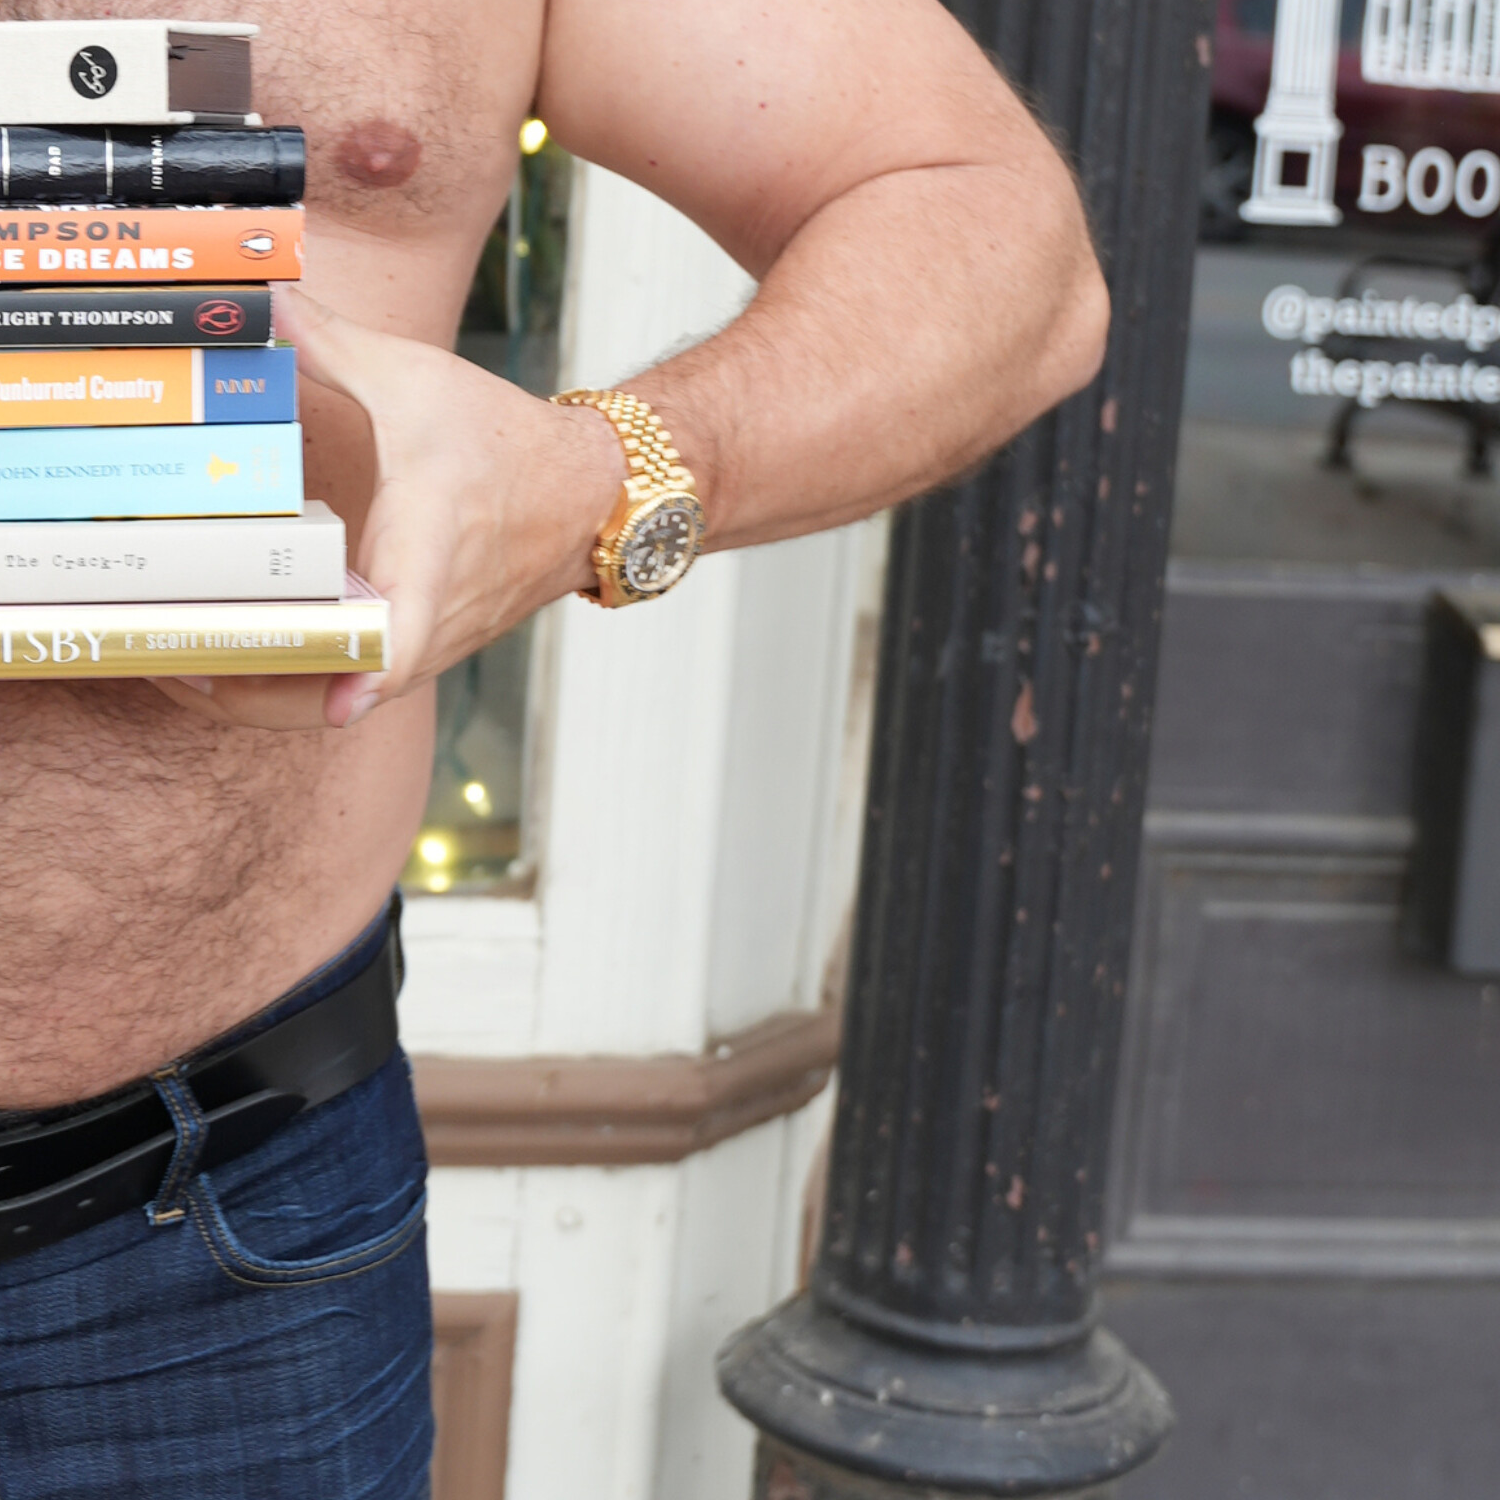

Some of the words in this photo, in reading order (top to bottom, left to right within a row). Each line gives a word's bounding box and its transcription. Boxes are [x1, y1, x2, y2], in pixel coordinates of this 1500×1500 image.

[48, 145, 62, 177] DAD
[38, 247, 194, 270] DREAMS
[58, 310, 174, 326] THOMPSON
[90, 374, 165, 404] Country
[44, 464, 124, 480] KENNEDY
[130, 463, 186, 477] TOOLE
[4, 553, 39, 568] The
[52, 553, 149, 570] Crack-Up
[124, 634, 140, 650] F.
[146, 632, 198, 650] SCOTT
[204, 631, 306, 649] FITZGERALD
